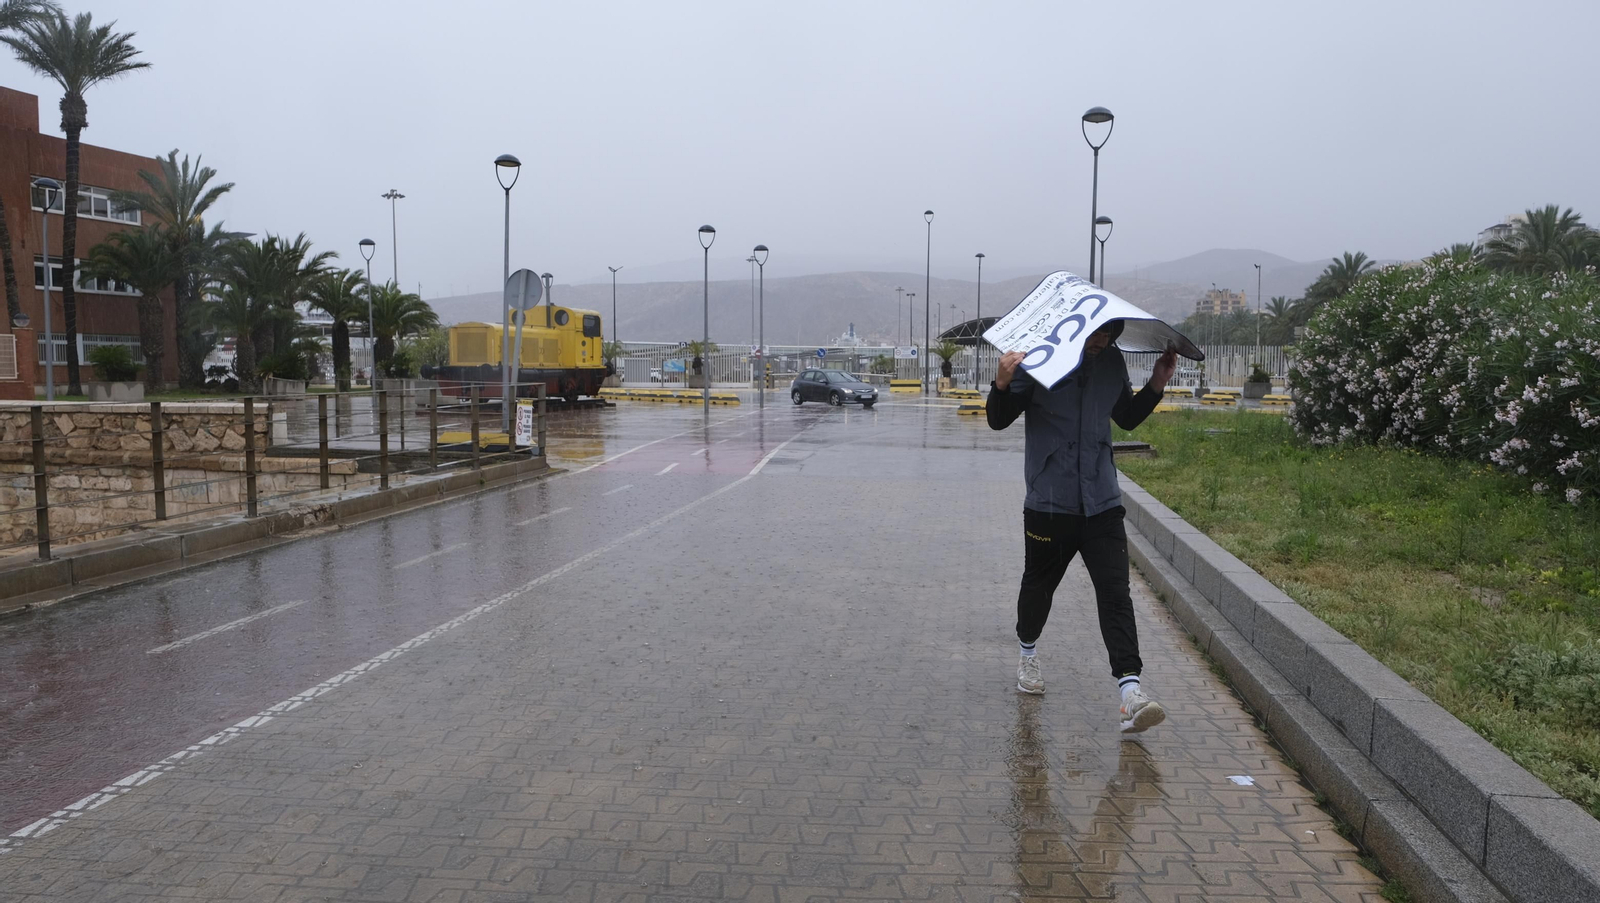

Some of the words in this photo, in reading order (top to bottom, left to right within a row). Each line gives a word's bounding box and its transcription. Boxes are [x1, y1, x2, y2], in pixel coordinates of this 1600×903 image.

[1069, 288, 1089, 304] RED
[1055, 308, 1069, 320] DE
[1020, 324, 1054, 353] TALLE
